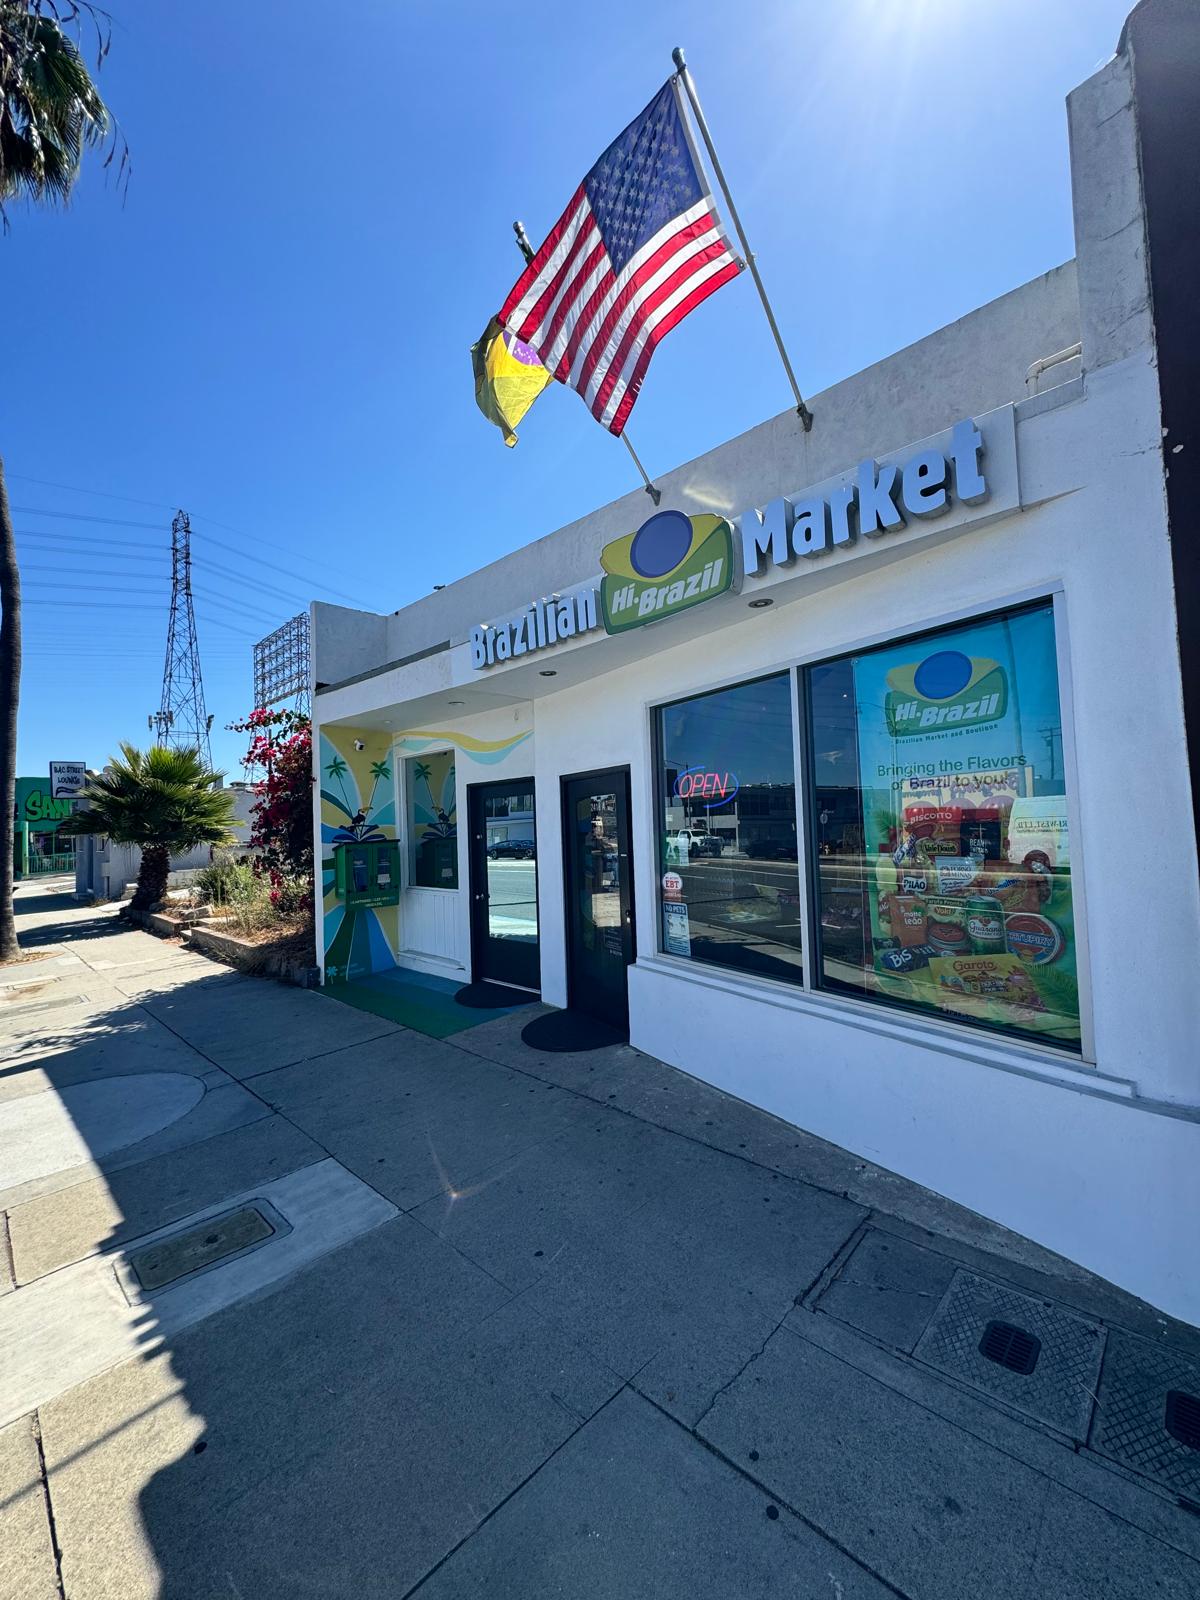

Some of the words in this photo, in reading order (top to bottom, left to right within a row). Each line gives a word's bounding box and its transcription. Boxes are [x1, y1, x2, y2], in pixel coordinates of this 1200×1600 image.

[741, 418, 990, 579] Market
[470, 587, 599, 671] Brazilian
[925, 733, 949, 742] Market
[965, 723, 999, 736] Boutique
[877, 763, 936, 777] Bringing
[938, 759, 963, 772] the
[967, 754, 1027, 770] Flavors
[679, 772, 729, 799] OPEN
[891, 778, 904, 791] of
[909, 774, 951, 790] Brazil
[954, 776, 970, 787] to
[973, 770, 1009, 789] you!
[665, 844, 677, 860] A
[665, 880, 680, 889] EBT
[665, 904, 673, 912] NO
[953, 960, 995, 972] Garoto
